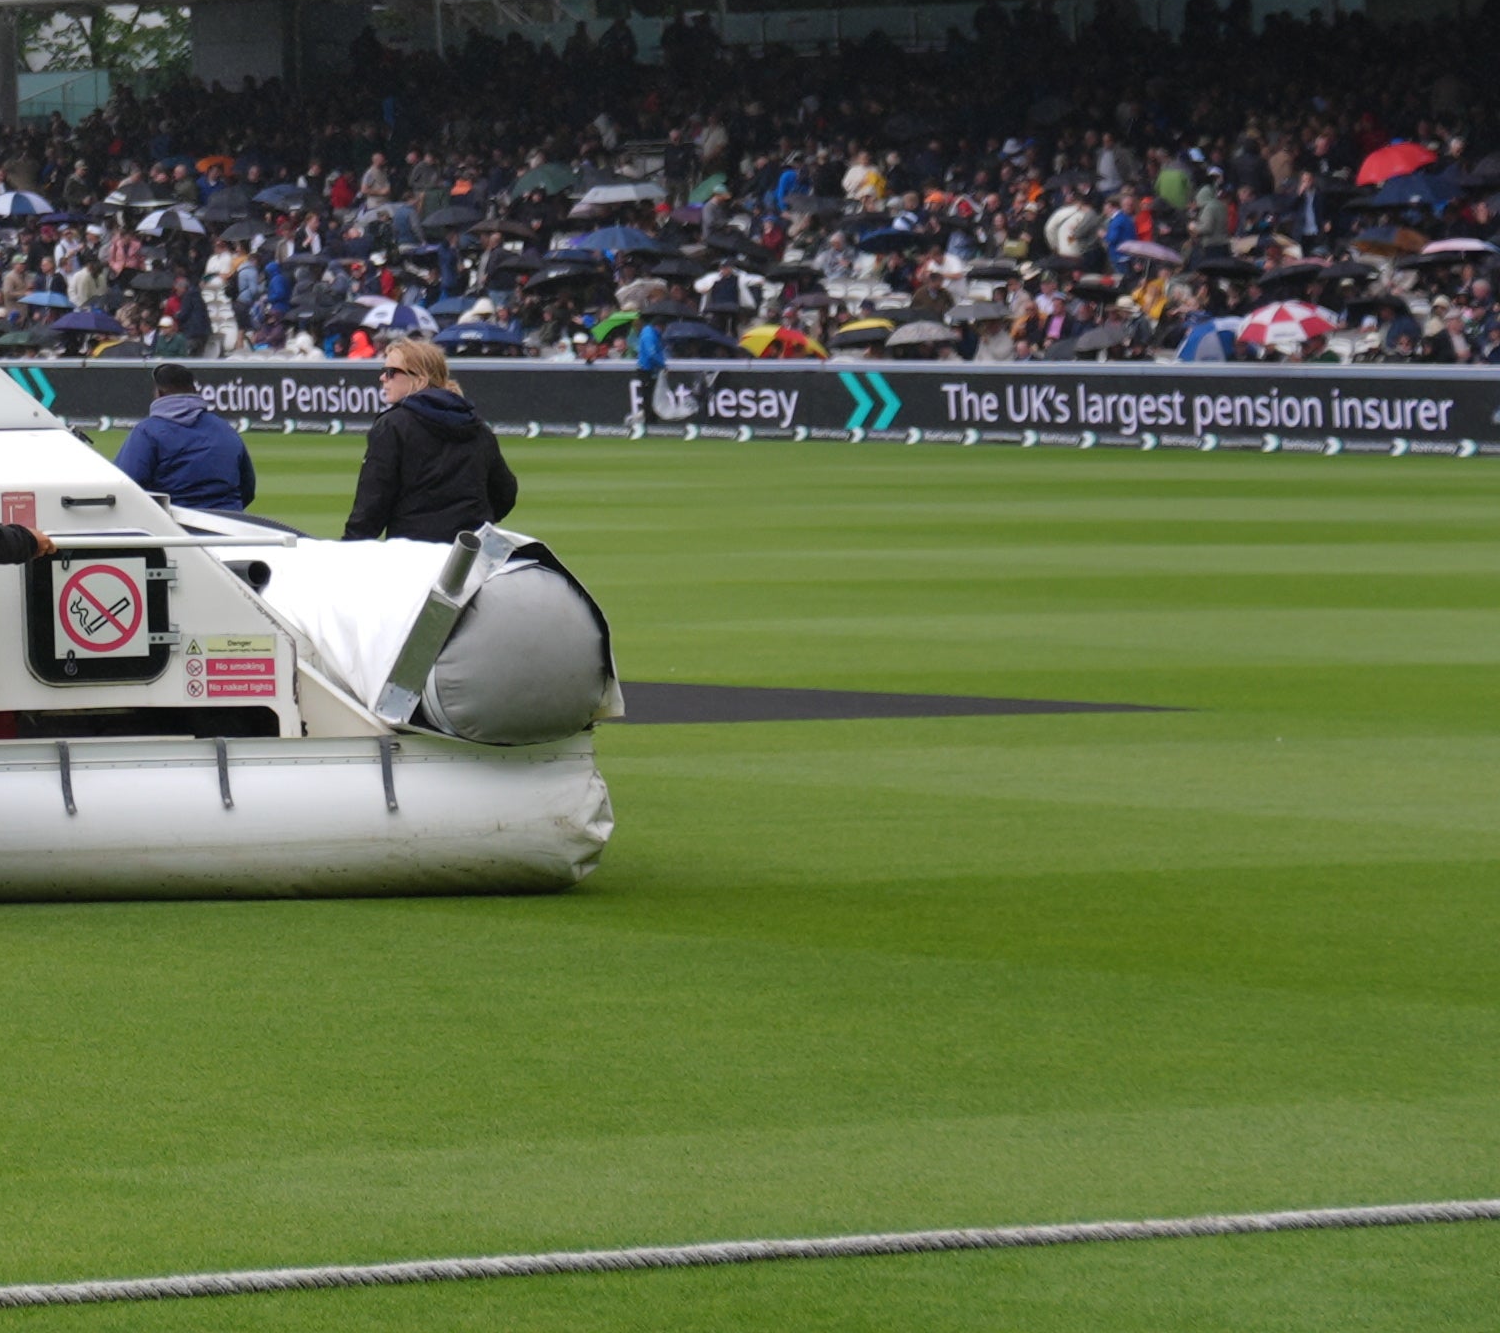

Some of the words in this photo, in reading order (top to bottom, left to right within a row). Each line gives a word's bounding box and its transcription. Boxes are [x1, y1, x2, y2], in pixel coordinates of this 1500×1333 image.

[940, 383, 998, 422] The
[1005, 383, 1070, 423] UK's
[1076, 383, 1186, 435] largest
[1193, 386, 1323, 437] pension
[1330, 387, 1454, 431] insurer
[227, 640, 252, 648] Danger
[215, 662, 228, 671] No
[230, 662, 266, 673] smoking
[209, 683, 221, 692] No
[223, 683, 248, 692] naked
[250, 683, 273, 694] lights
